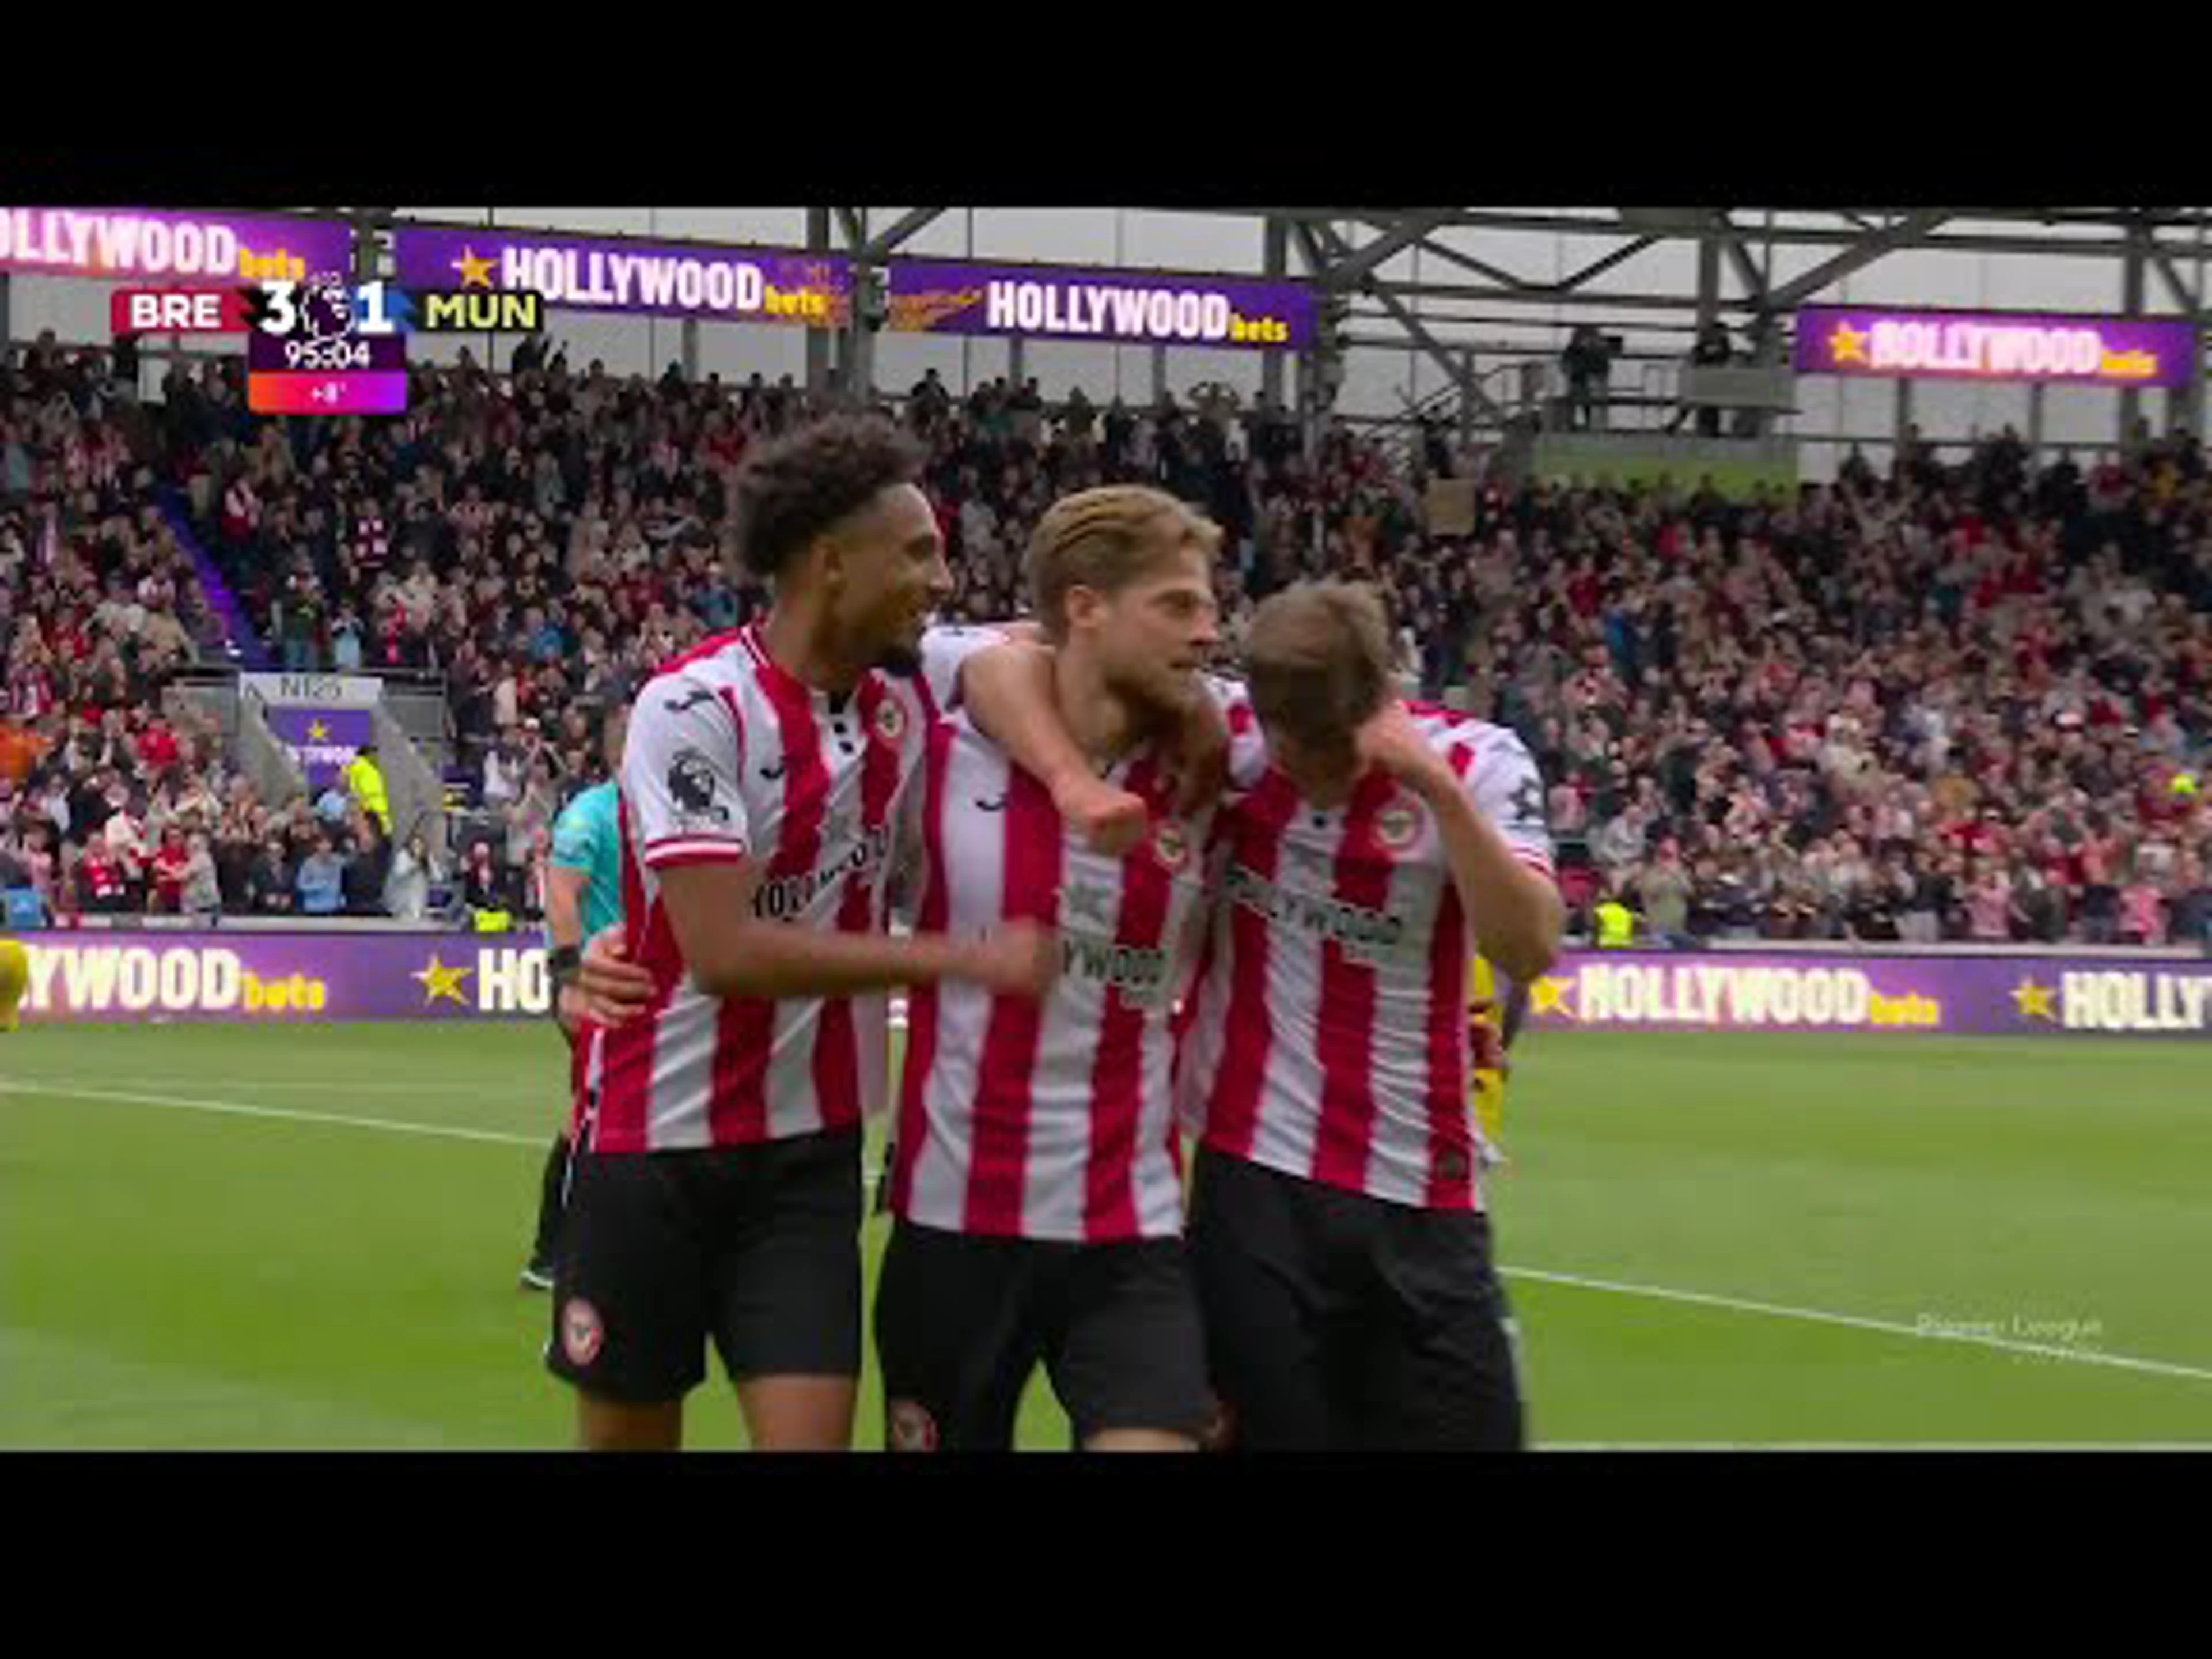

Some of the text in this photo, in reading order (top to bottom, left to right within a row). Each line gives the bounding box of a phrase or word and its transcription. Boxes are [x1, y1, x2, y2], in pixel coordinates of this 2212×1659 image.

[238, 248, 305, 280] bets
[502, 247, 828, 315] HOLLYWOOD bets
[987, 281, 1289, 343] HOLLYWOOD bets
[1870, 321, 2100, 374] HOLLYWOOD
[242, 971, 325, 1010] bets
[1580, 964, 1869, 1025] HOLLYWOOD
